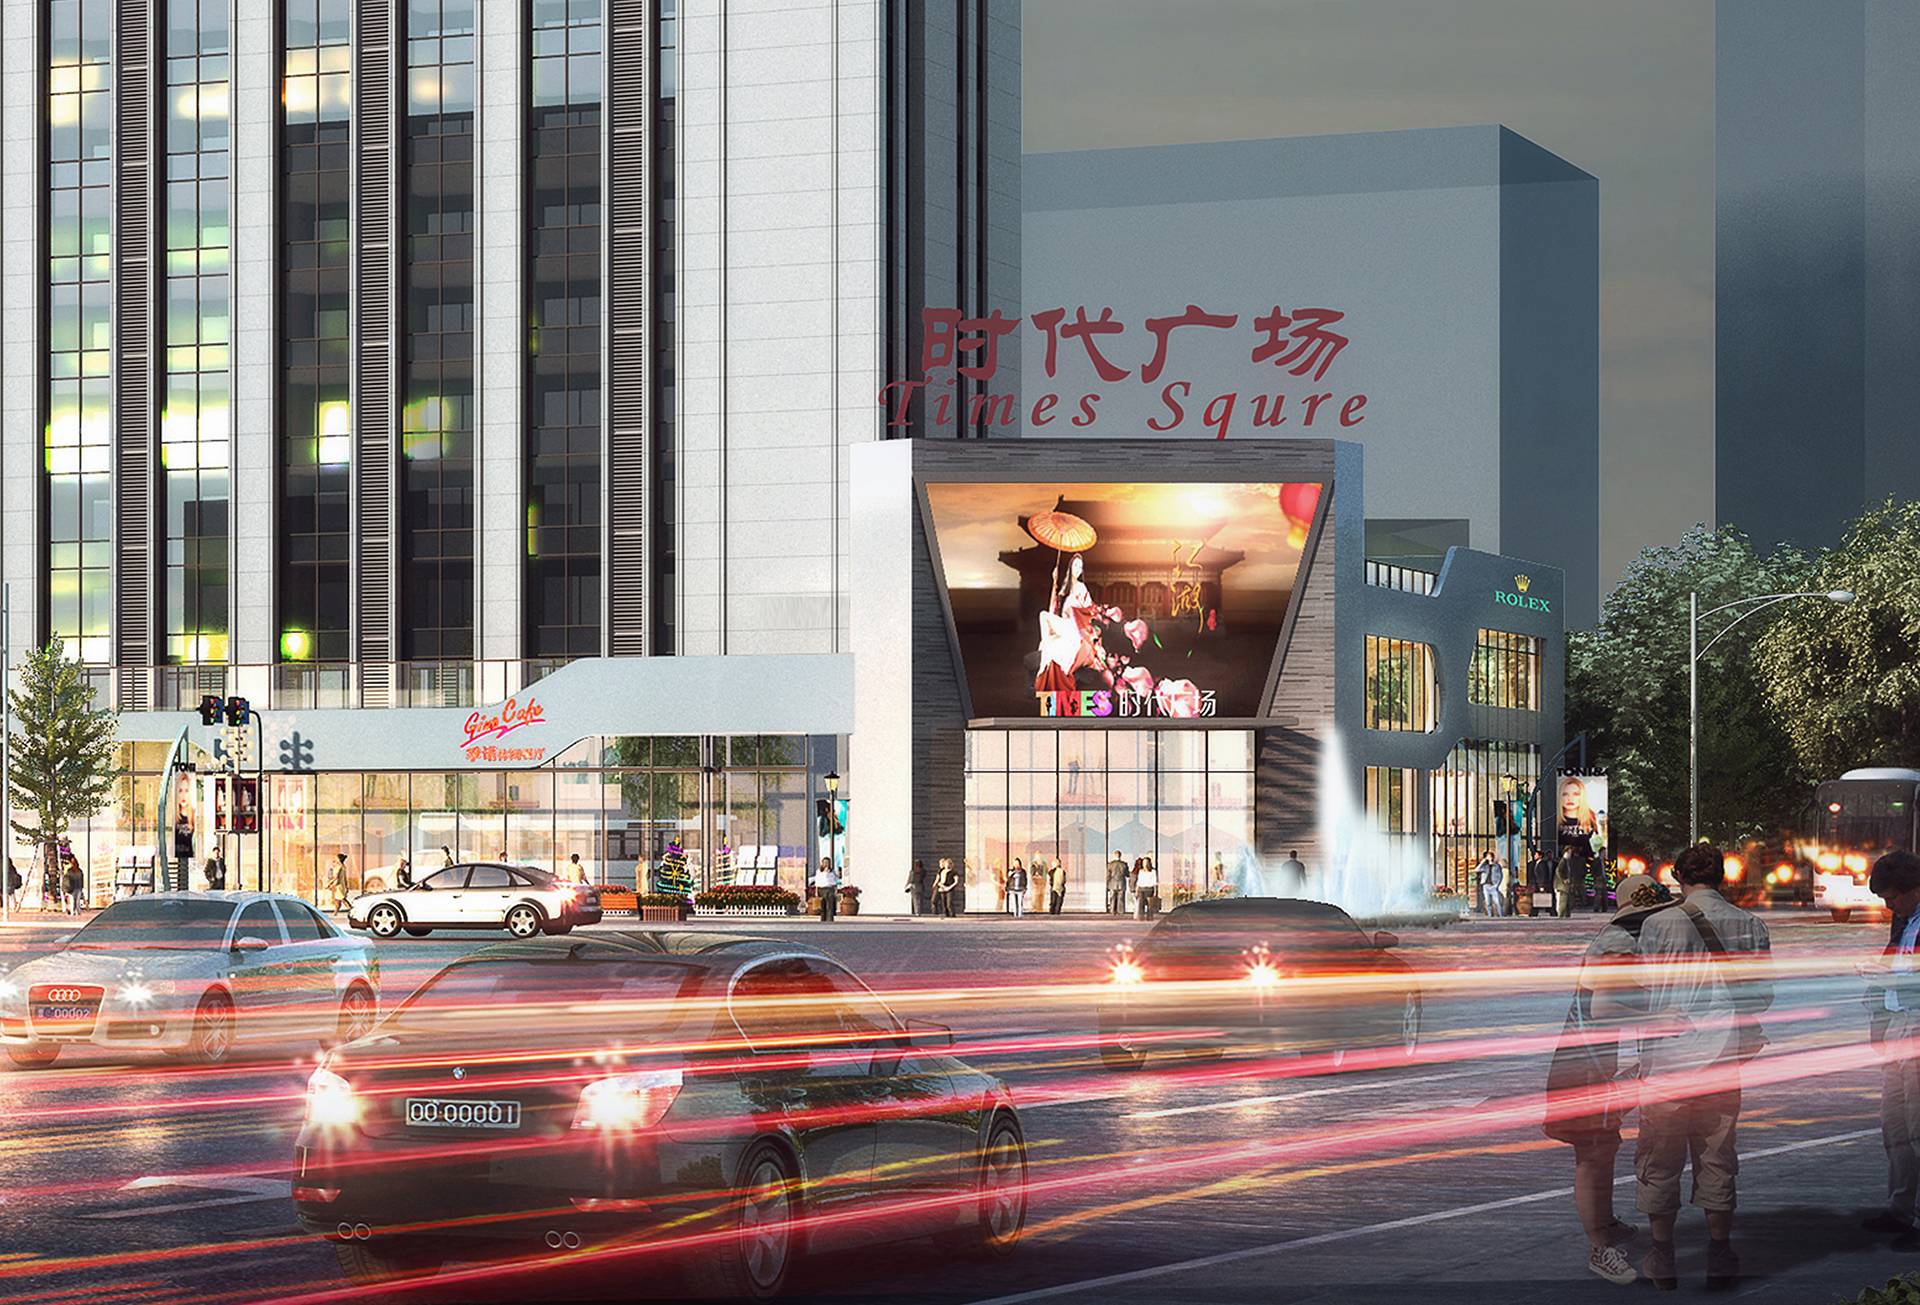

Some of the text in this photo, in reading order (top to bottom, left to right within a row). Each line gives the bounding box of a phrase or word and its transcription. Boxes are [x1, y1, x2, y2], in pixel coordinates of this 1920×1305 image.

[921, 304, 1350, 383] 时代广场
[878, 374, 1368, 439] Times Squre
[1495, 590, 1551, 613] ROLEX
[502, 698, 544, 725] Cafe
[1035, 690, 1113, 717] TIMES
